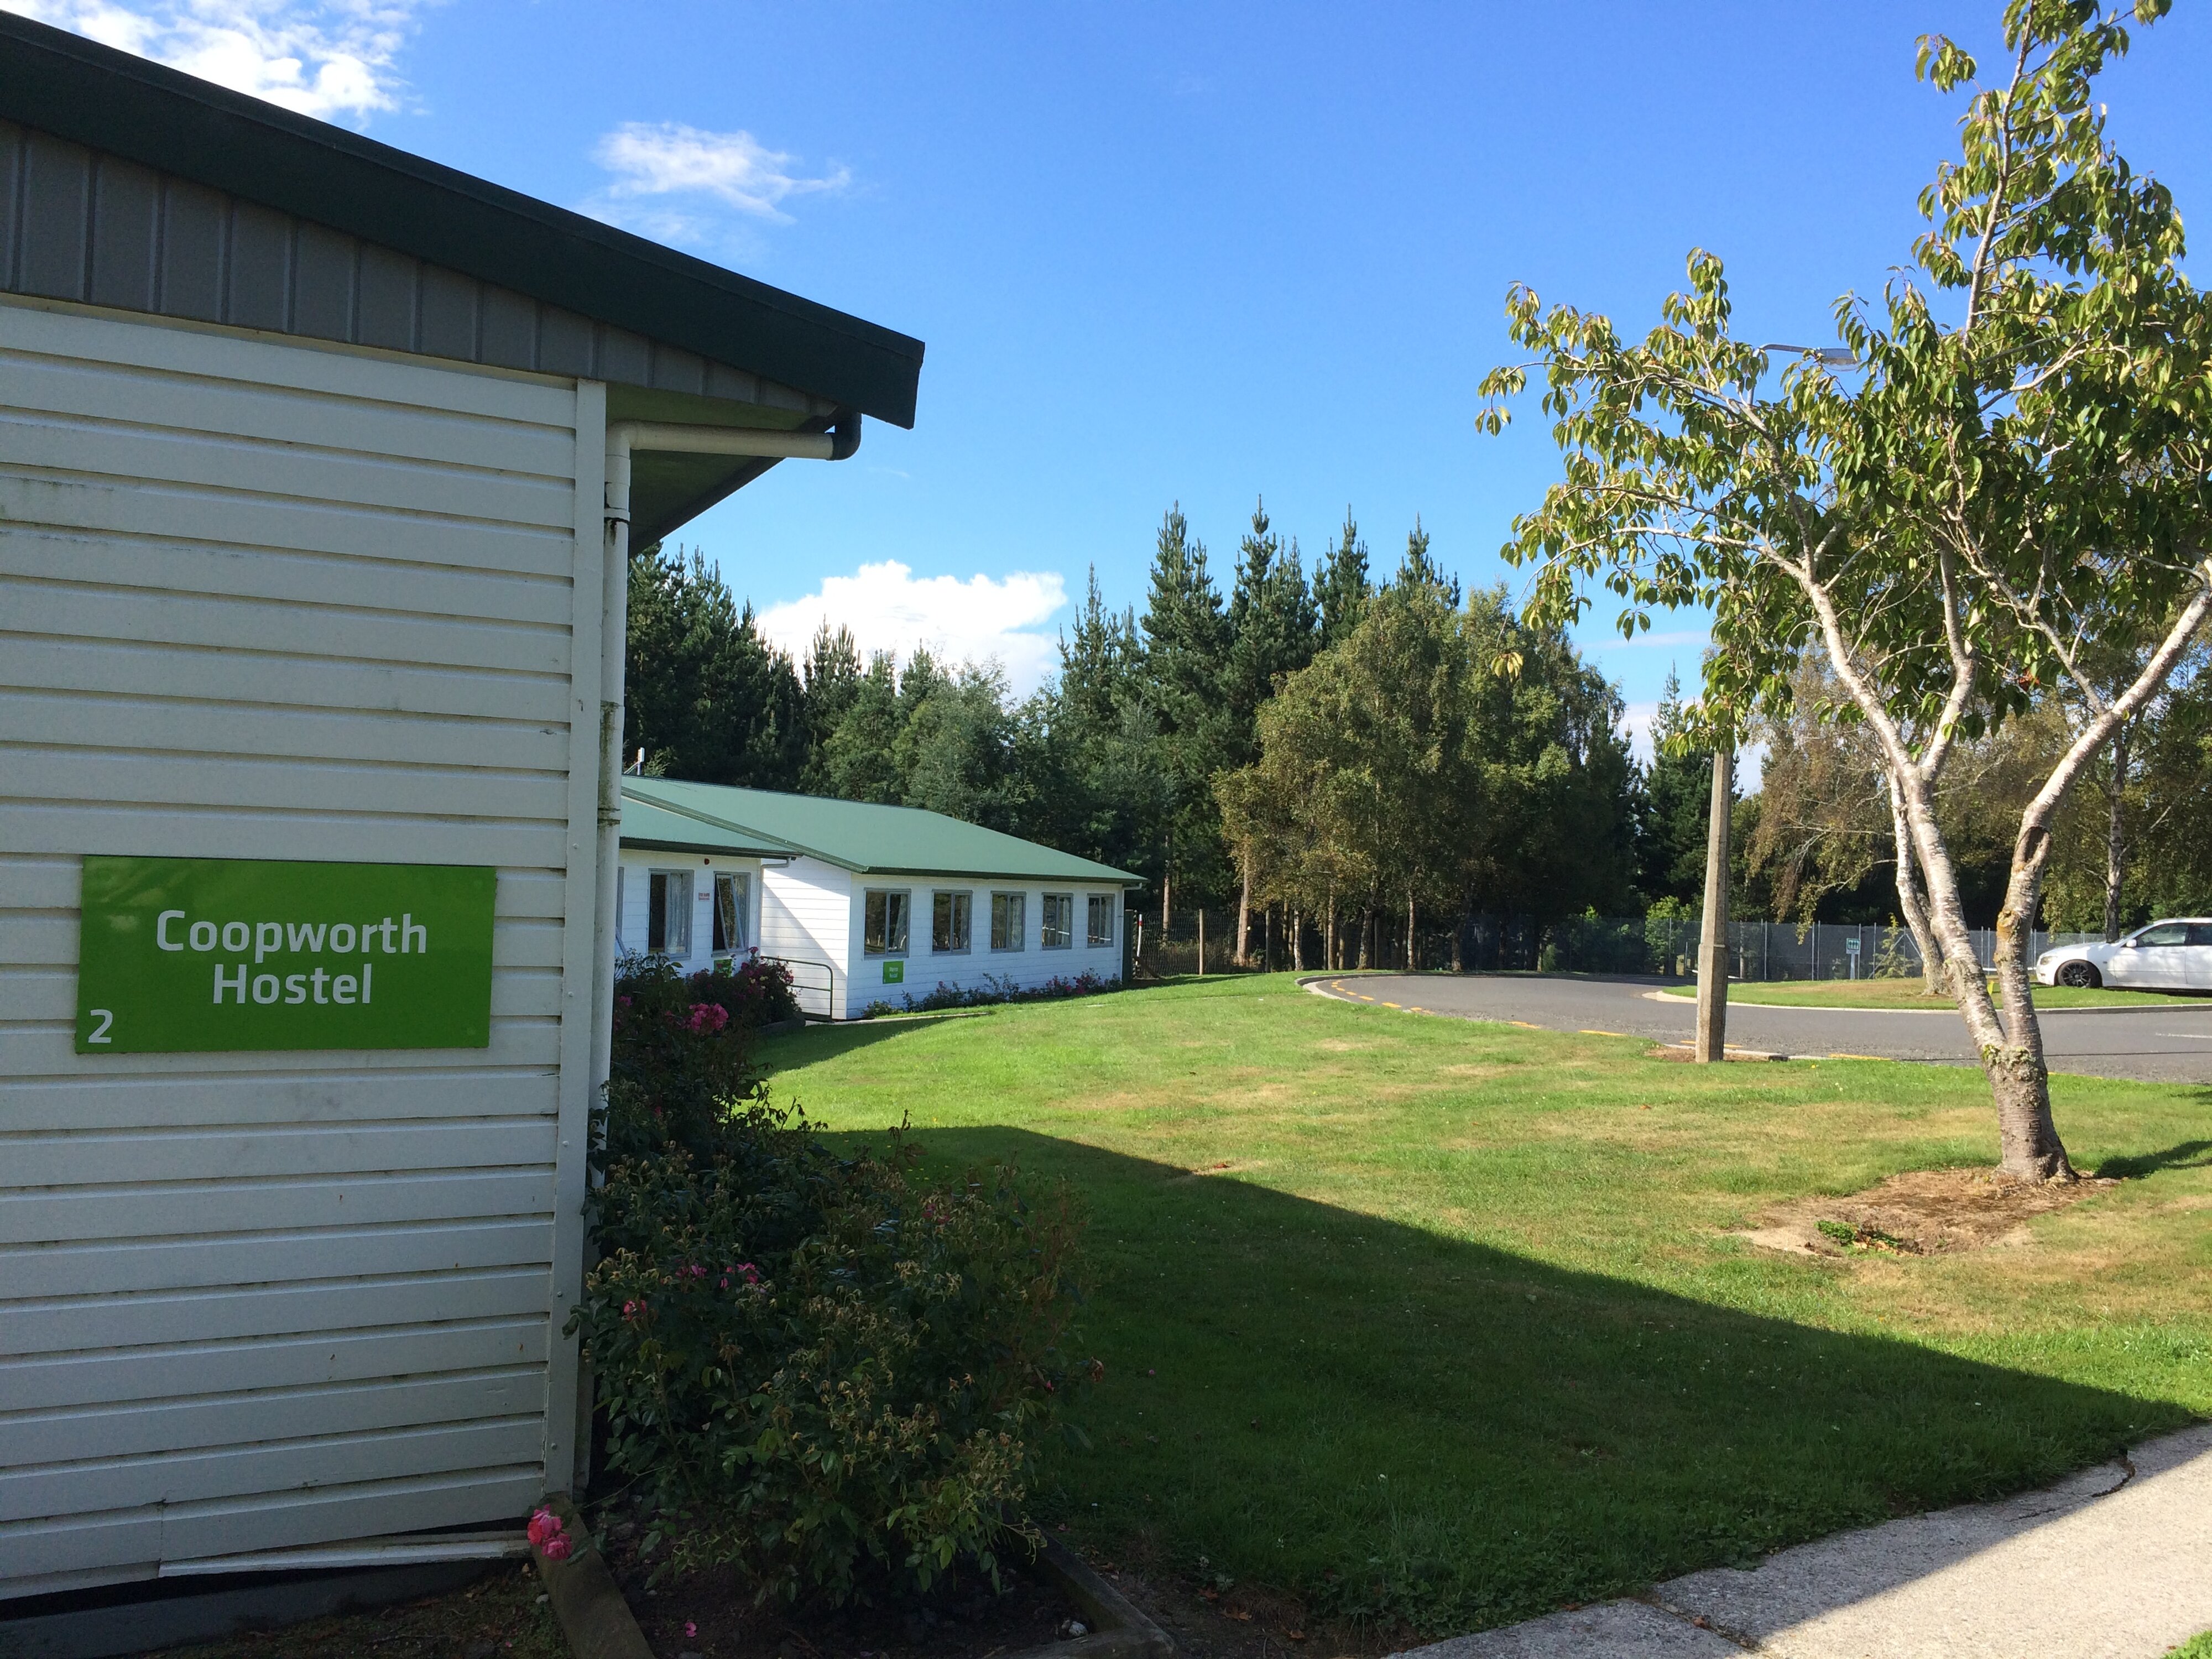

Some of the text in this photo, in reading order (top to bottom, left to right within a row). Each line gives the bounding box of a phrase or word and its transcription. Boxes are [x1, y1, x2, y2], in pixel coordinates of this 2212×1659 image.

[156, 910, 427, 963] Coopworth
[213, 964, 372, 1004] Hostel
[87, 1009, 113, 1044] 2
